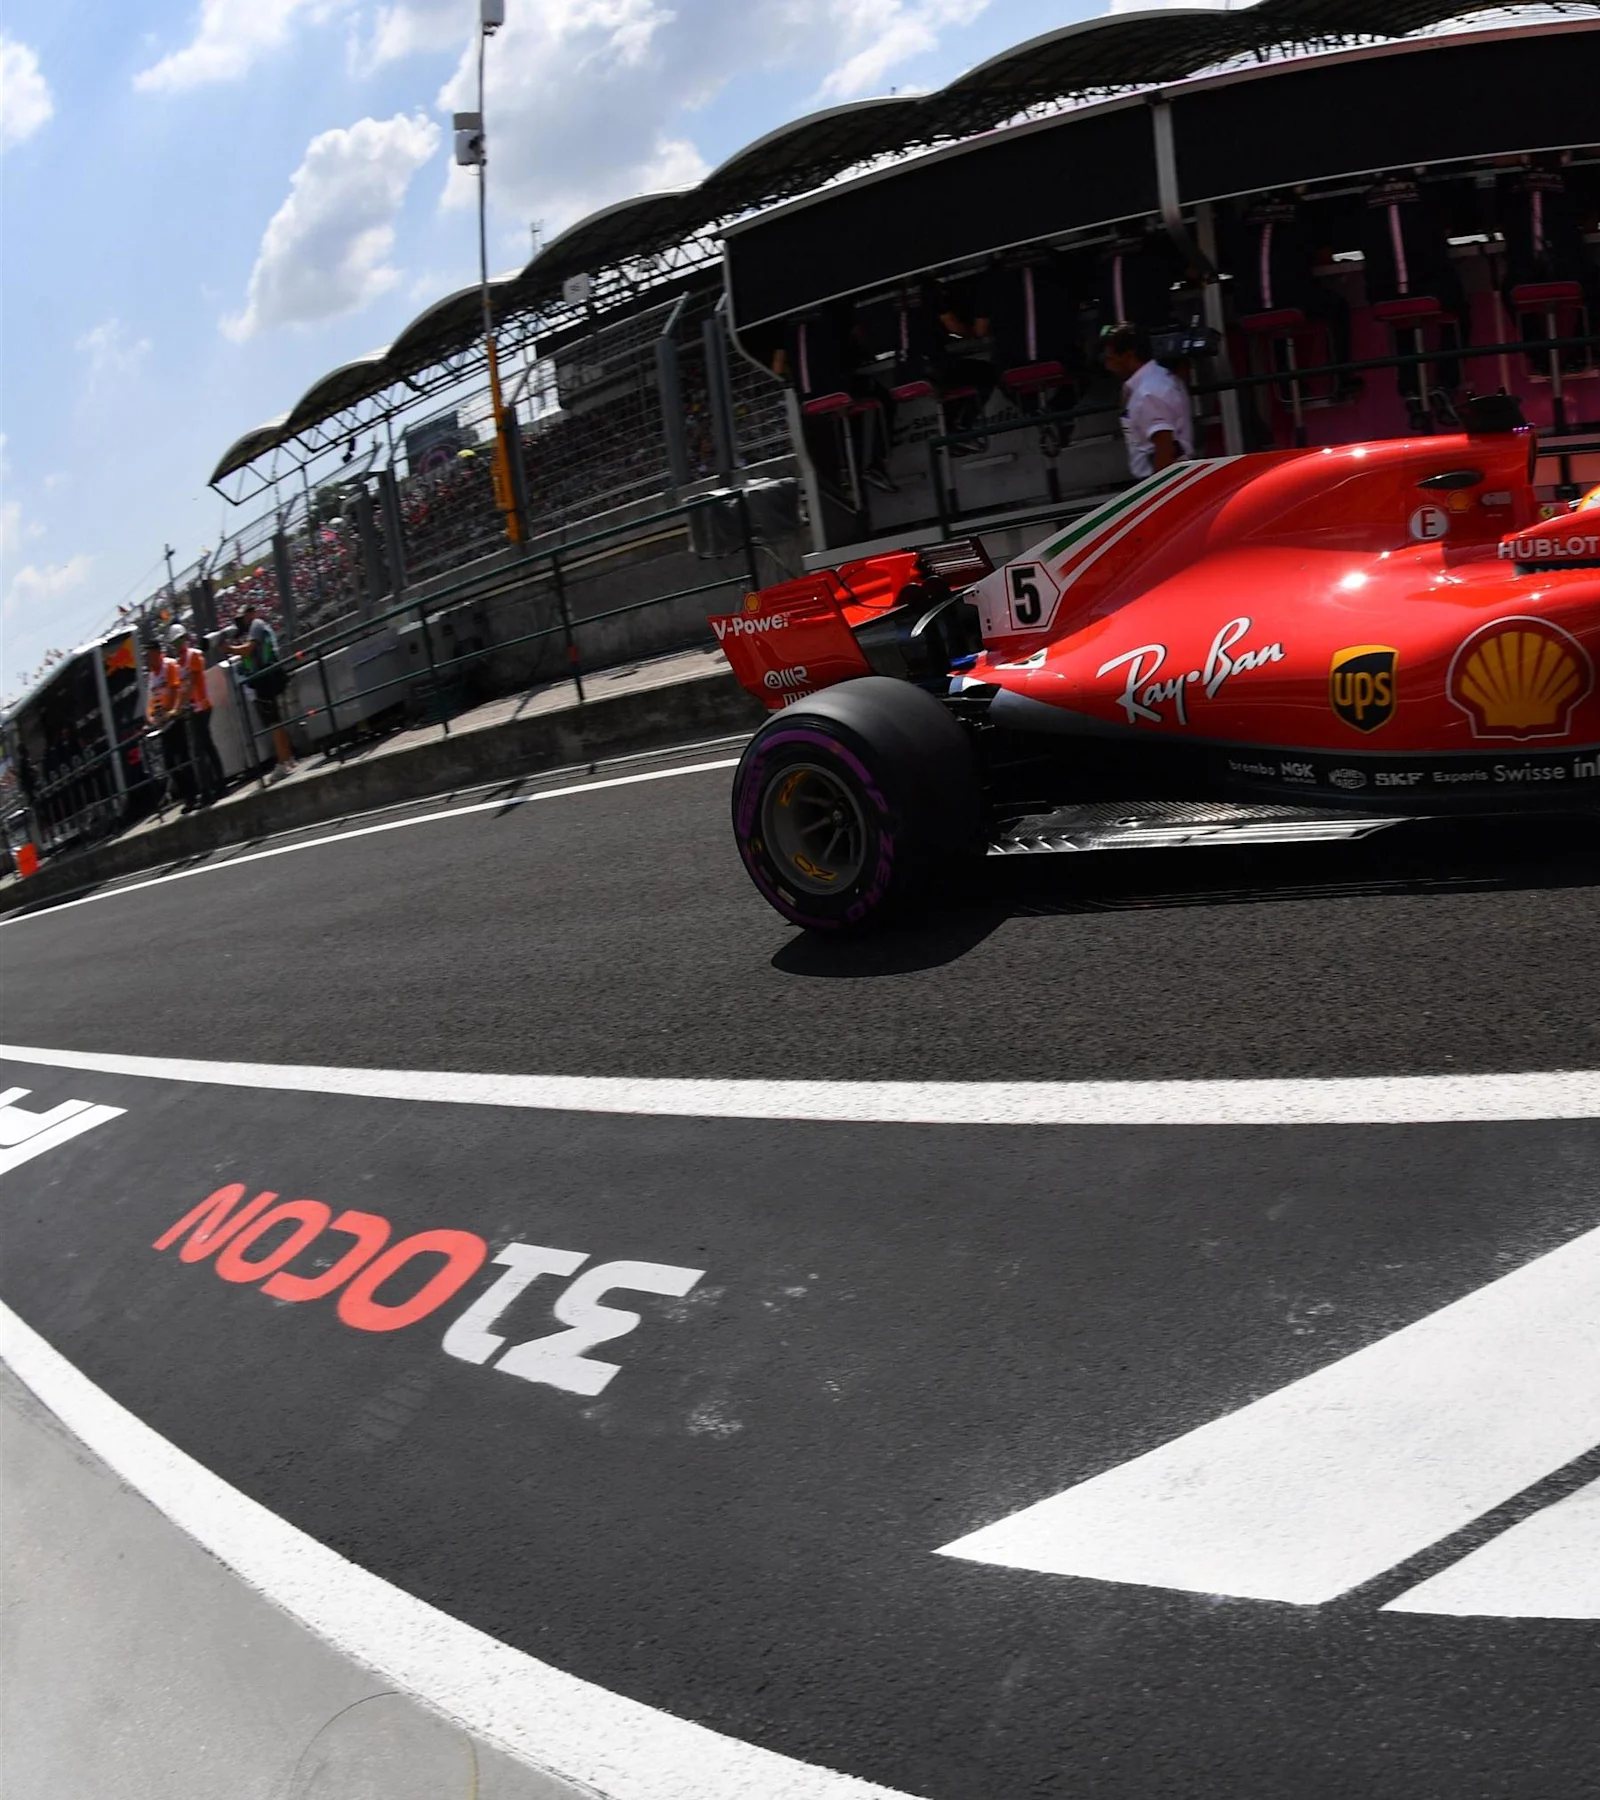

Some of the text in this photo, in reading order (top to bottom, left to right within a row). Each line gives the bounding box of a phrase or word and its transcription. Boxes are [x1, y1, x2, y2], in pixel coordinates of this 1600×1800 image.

[1419, 508, 1437, 538] E
[1498, 535, 1600, 560] HUBLOT
[1010, 565, 1042, 626] 5
[1333, 671, 1392, 721] ups
[1281, 761, 1316, 778] NGK
[1374, 772, 1425, 787] SKF
[1493, 762, 1566, 783] Swisse
[151, 1182, 707, 1398] 31 OCON
